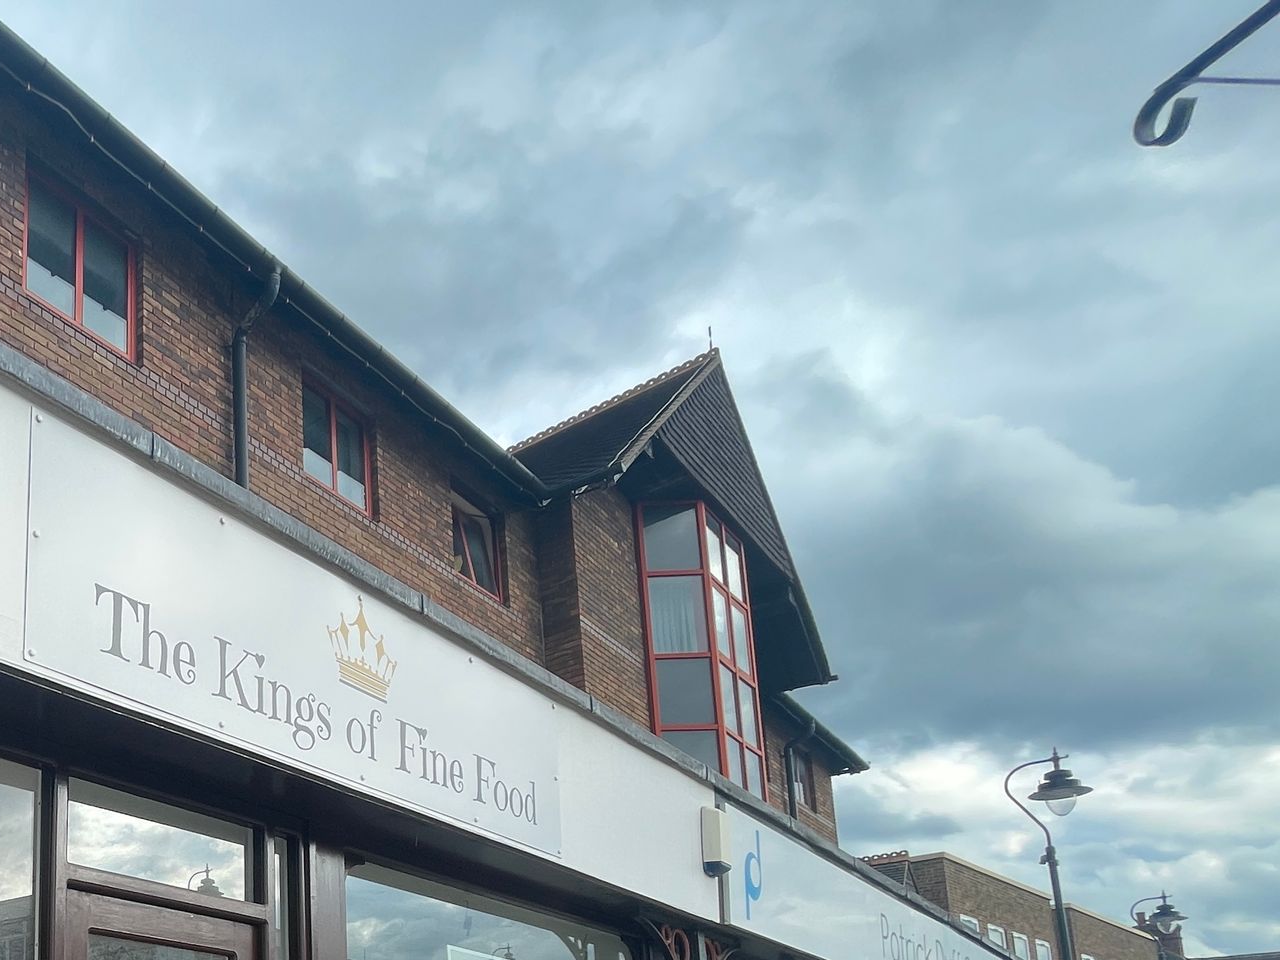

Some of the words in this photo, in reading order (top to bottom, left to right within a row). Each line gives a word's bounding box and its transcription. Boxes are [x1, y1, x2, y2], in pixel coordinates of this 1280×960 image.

[94, 583, 198, 686] The
[211, 635, 332, 751] Kings
[346, 708, 383, 762] of
[395, 718, 464, 793] Fine
[473, 753, 538, 826] Food
